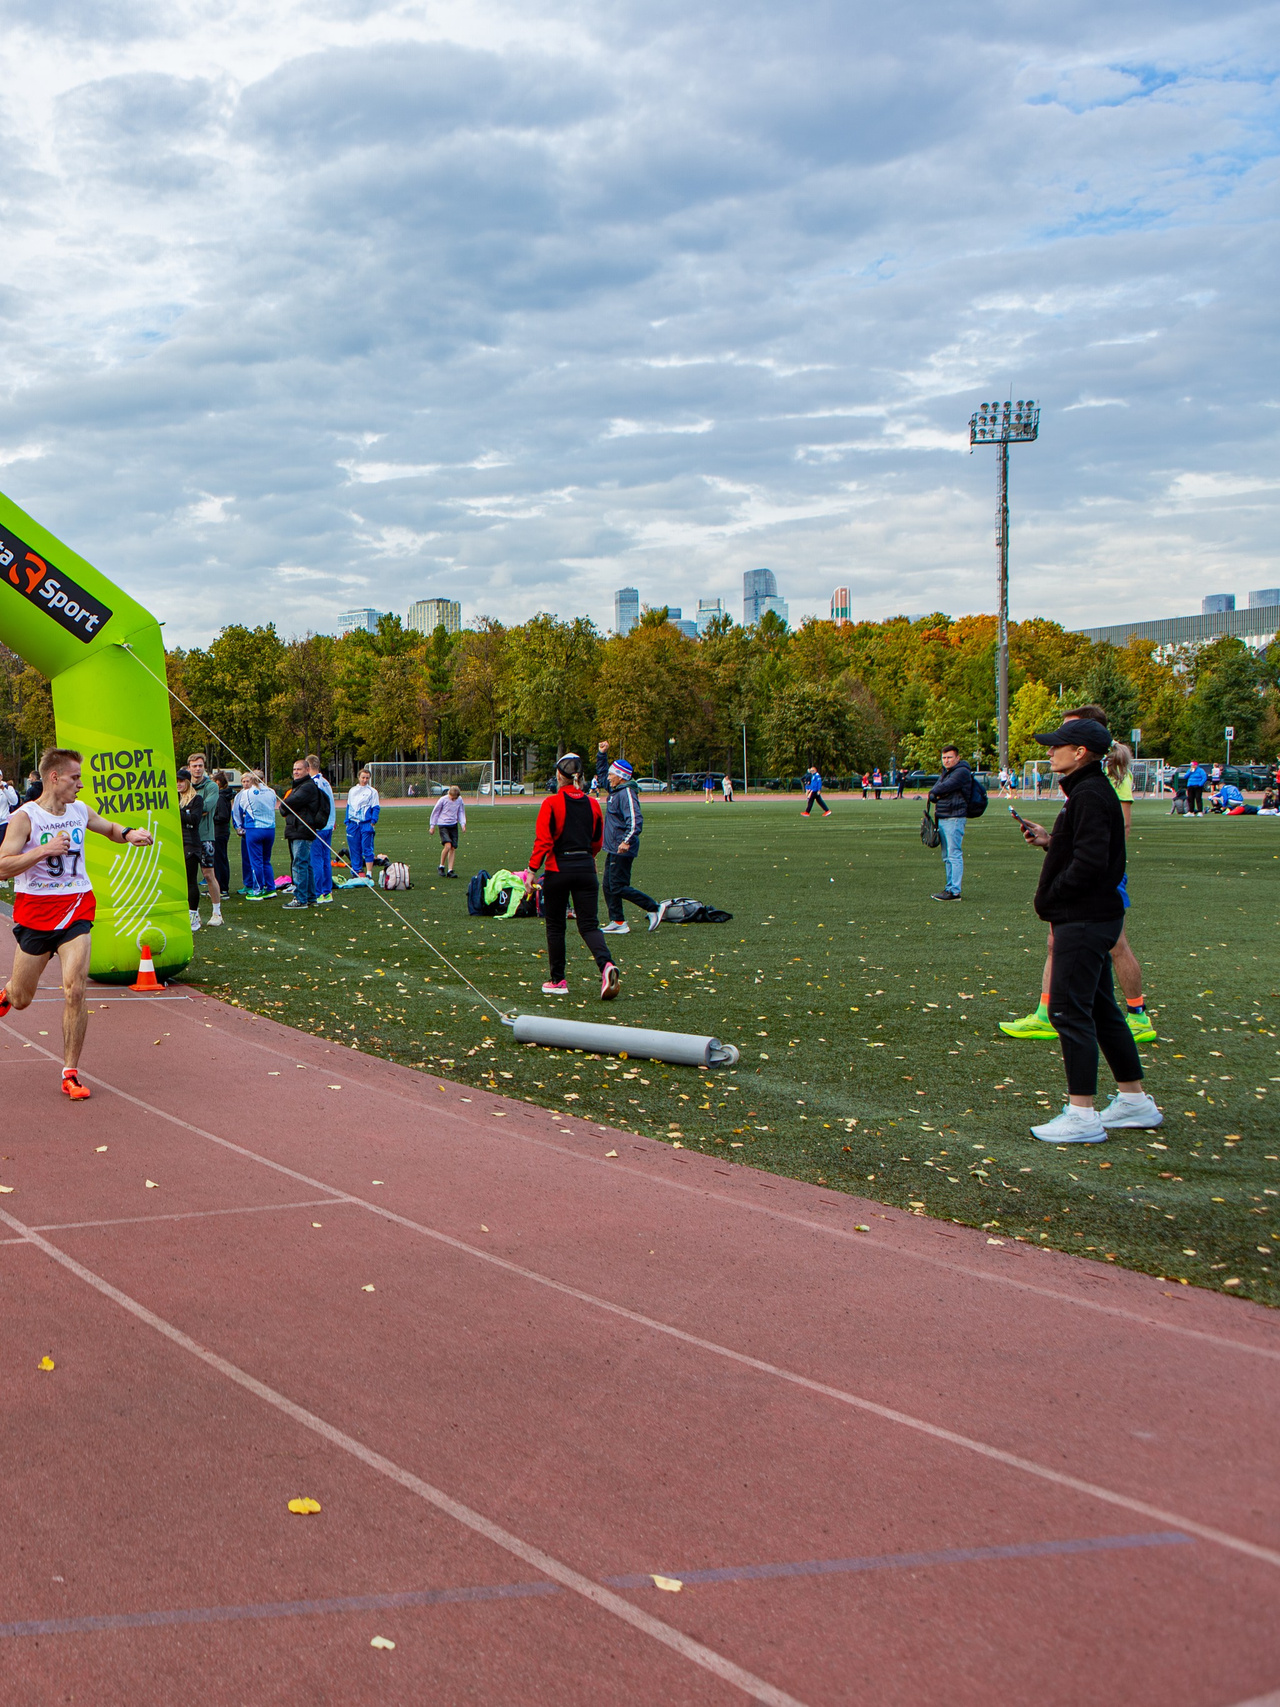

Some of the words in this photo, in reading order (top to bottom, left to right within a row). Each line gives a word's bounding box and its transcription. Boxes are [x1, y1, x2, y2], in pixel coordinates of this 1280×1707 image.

[38, 578, 101, 633] Sport
[90, 748, 154, 773] СПОРТ
[93, 769, 167, 795] НОРМА
[95, 790, 170, 816] ЖИЗНИ
[46, 848, 82, 879] 97
